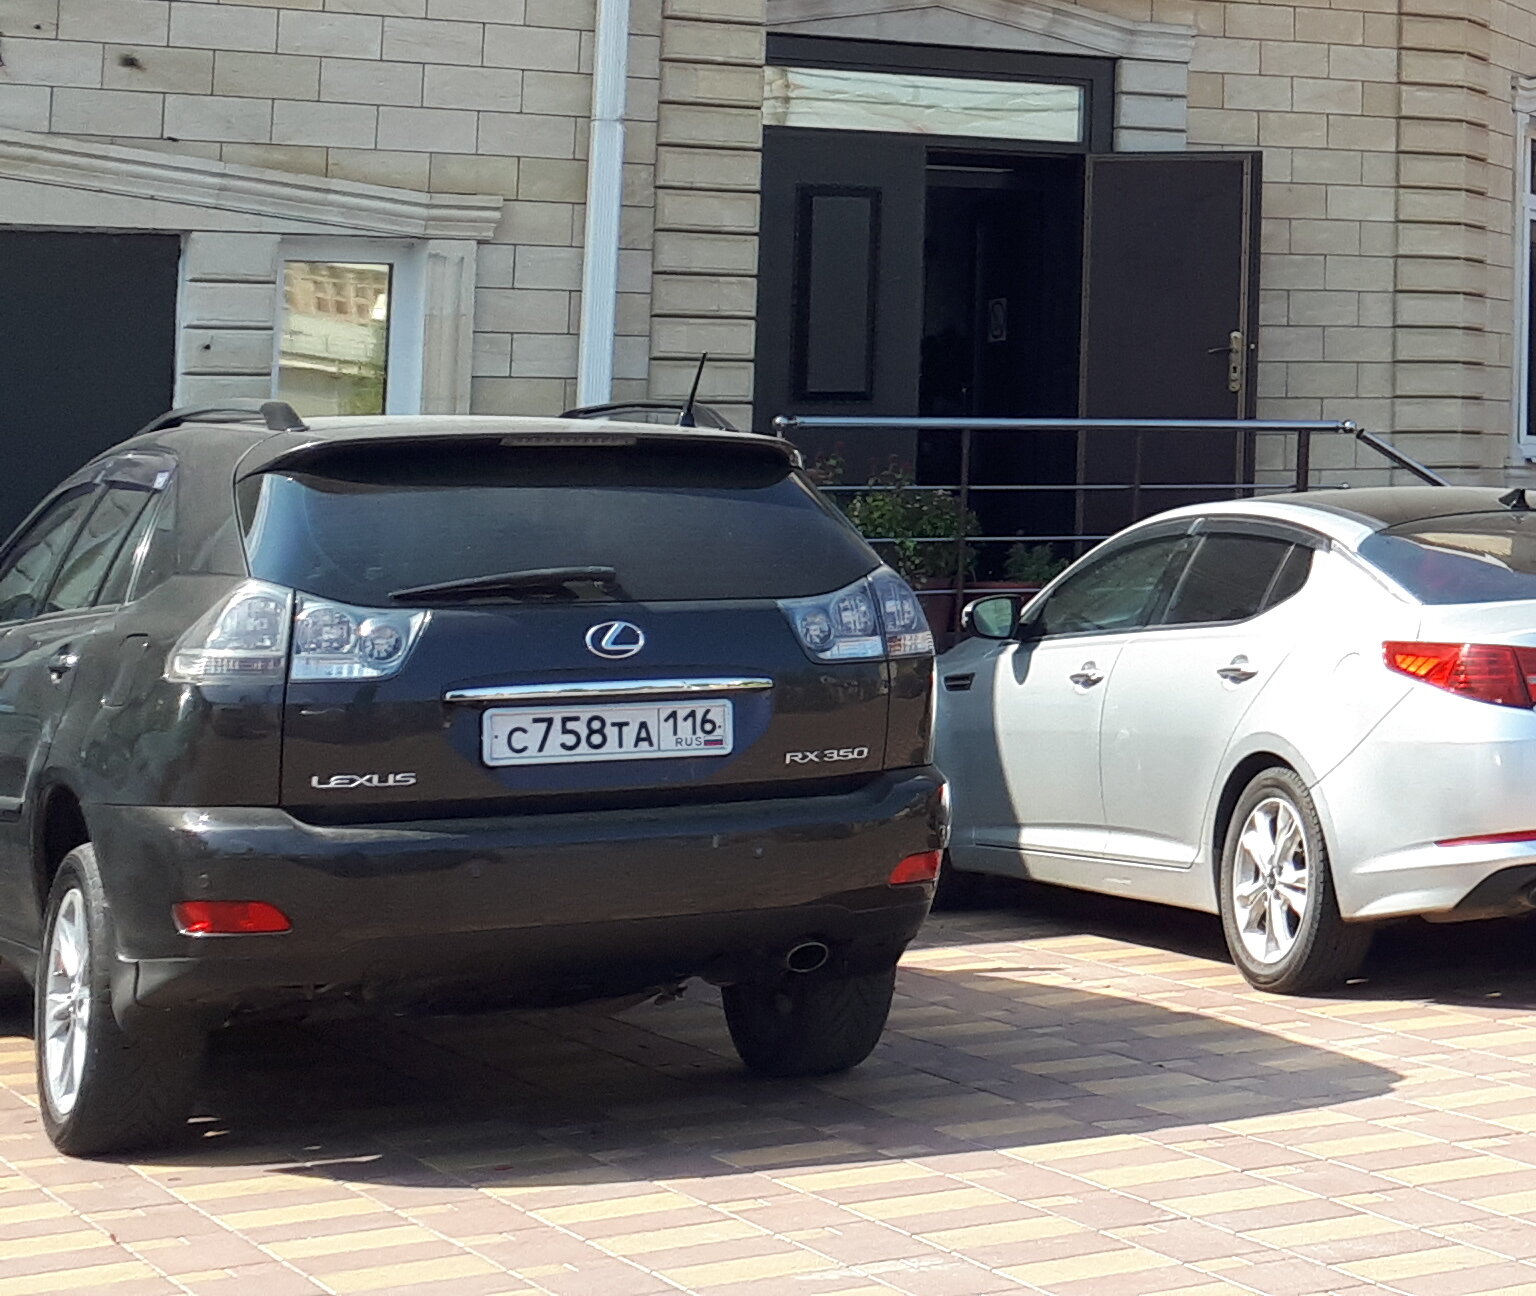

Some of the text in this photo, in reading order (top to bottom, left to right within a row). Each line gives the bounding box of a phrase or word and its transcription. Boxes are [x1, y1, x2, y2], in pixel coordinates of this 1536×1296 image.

[663, 708, 718, 737] 116
[674, 736, 703, 747] RUS
[785, 746, 869, 764] RX 350
[310, 772, 417, 789] LEXUS
